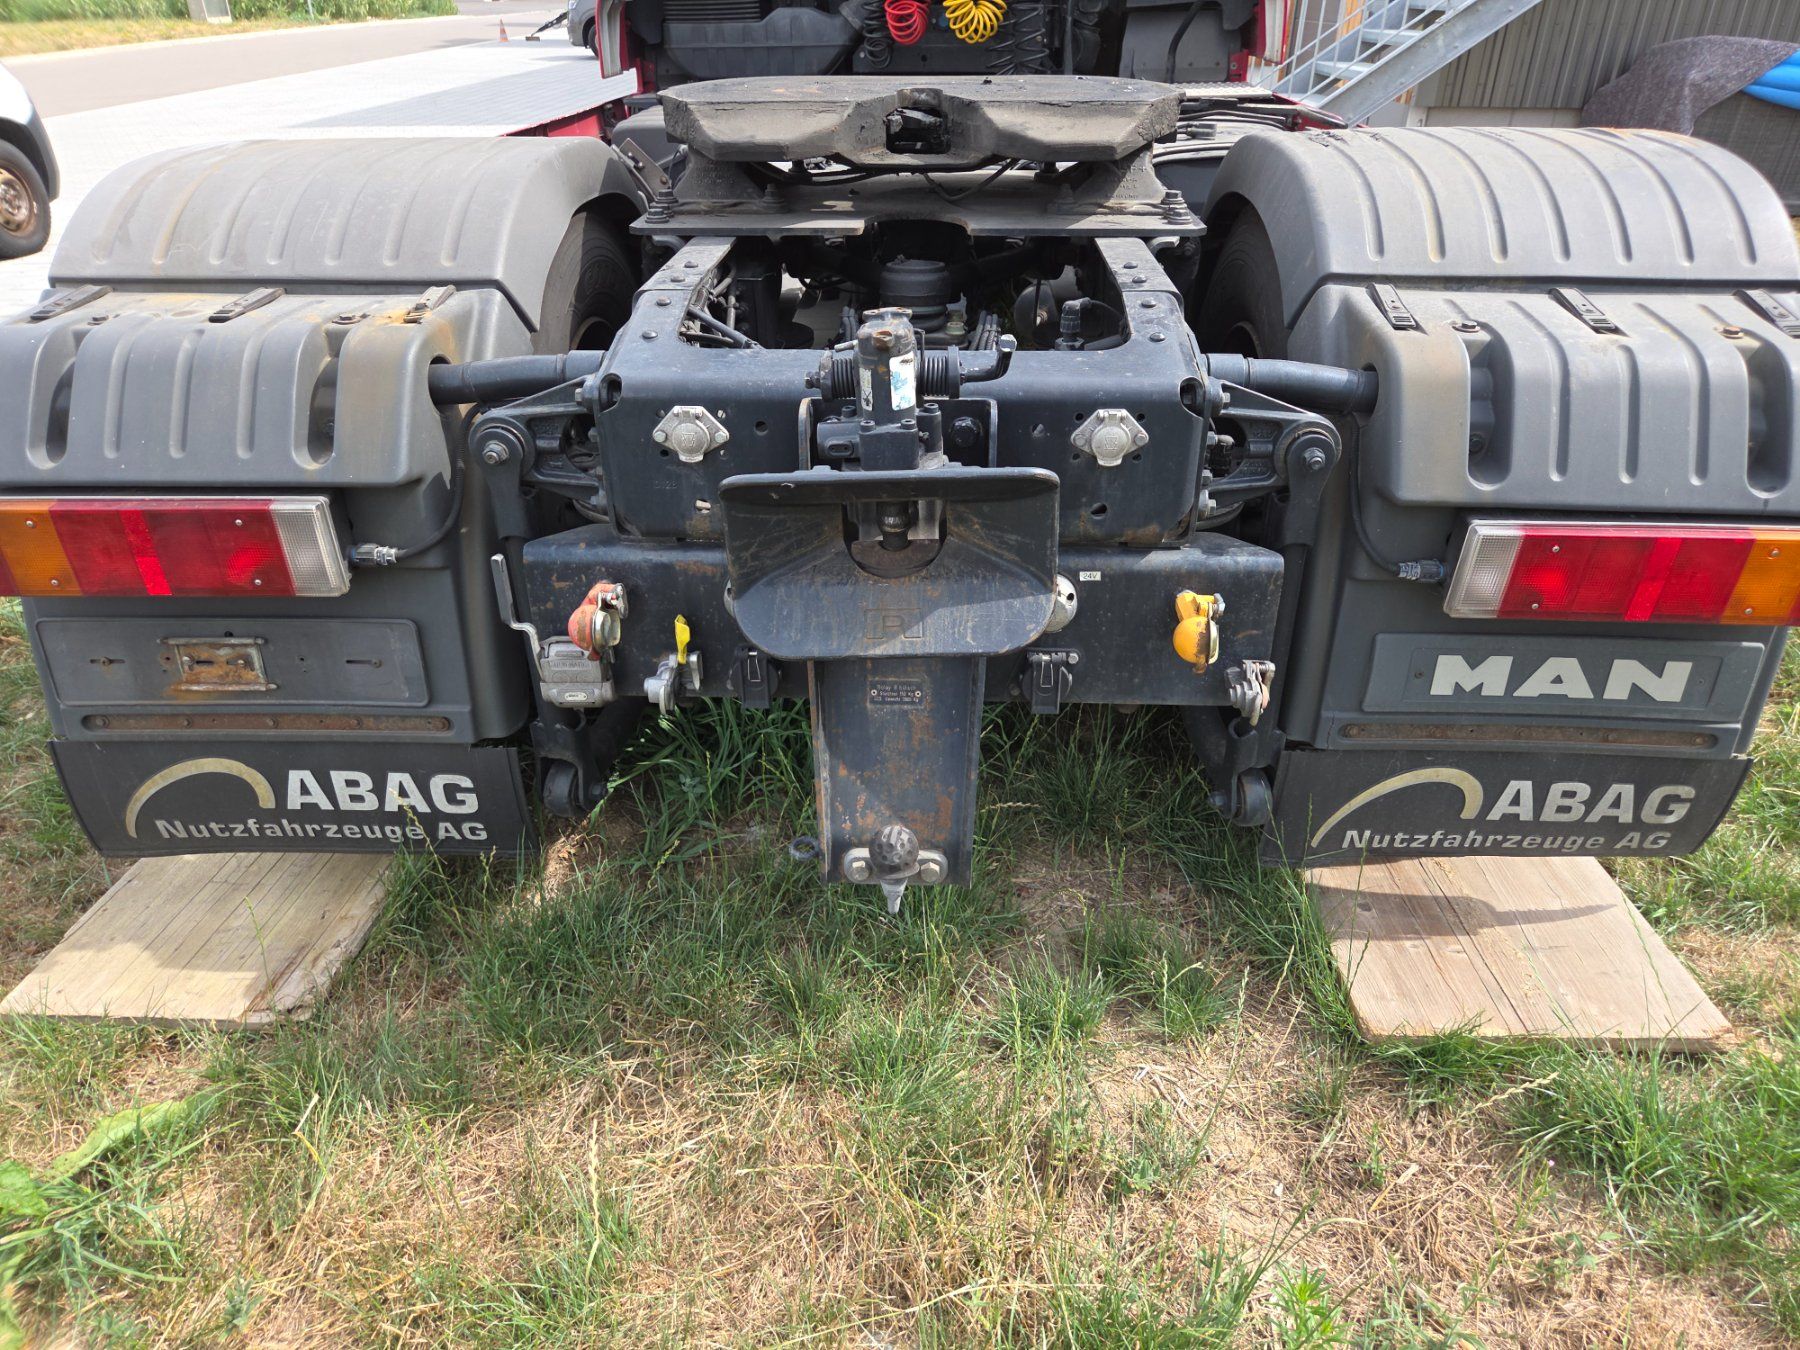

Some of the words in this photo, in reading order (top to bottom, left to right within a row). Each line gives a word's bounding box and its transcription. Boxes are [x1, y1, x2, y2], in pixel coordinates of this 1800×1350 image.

[1083, 572, 1098, 580] 24V
[1430, 654, 1693, 702] MAN
[287, 769, 479, 815] ABAG
[1486, 780, 1697, 824] ABAG
[154, 818, 425, 843] Nutzfahrzeuge
[437, 821, 488, 841] AG
[1341, 829, 1606, 852] Nutzfahrzeuge
[1614, 831, 1672, 850] AG
